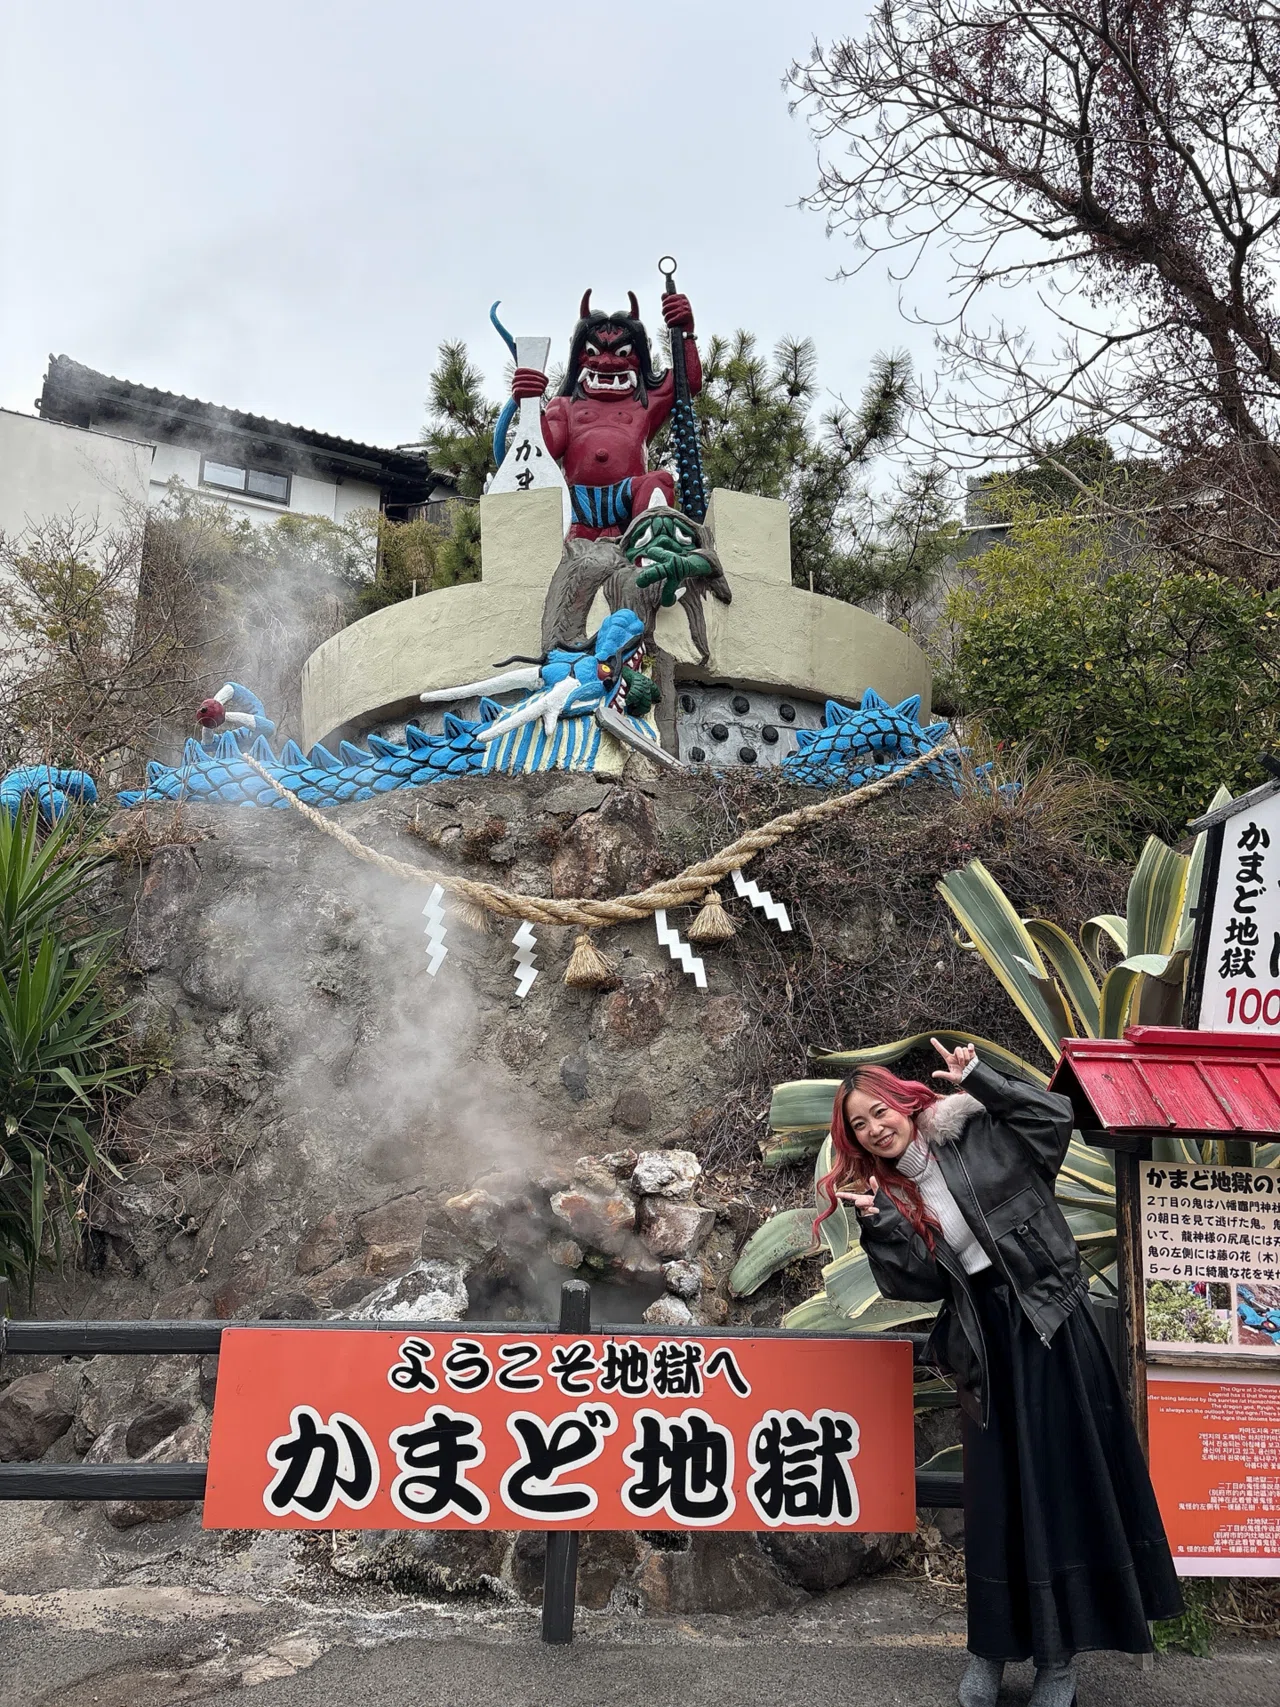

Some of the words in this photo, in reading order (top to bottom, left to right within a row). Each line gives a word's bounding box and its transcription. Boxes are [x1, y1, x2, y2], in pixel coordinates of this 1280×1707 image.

[1218, 822, 1270, 979] かまど地獄
[1146, 1167, 1280, 1195] かまど地獄の
[387, 1337, 751, 1397] ようこそ地獄へ
[264, 1402, 860, 1525] かまど地獄
